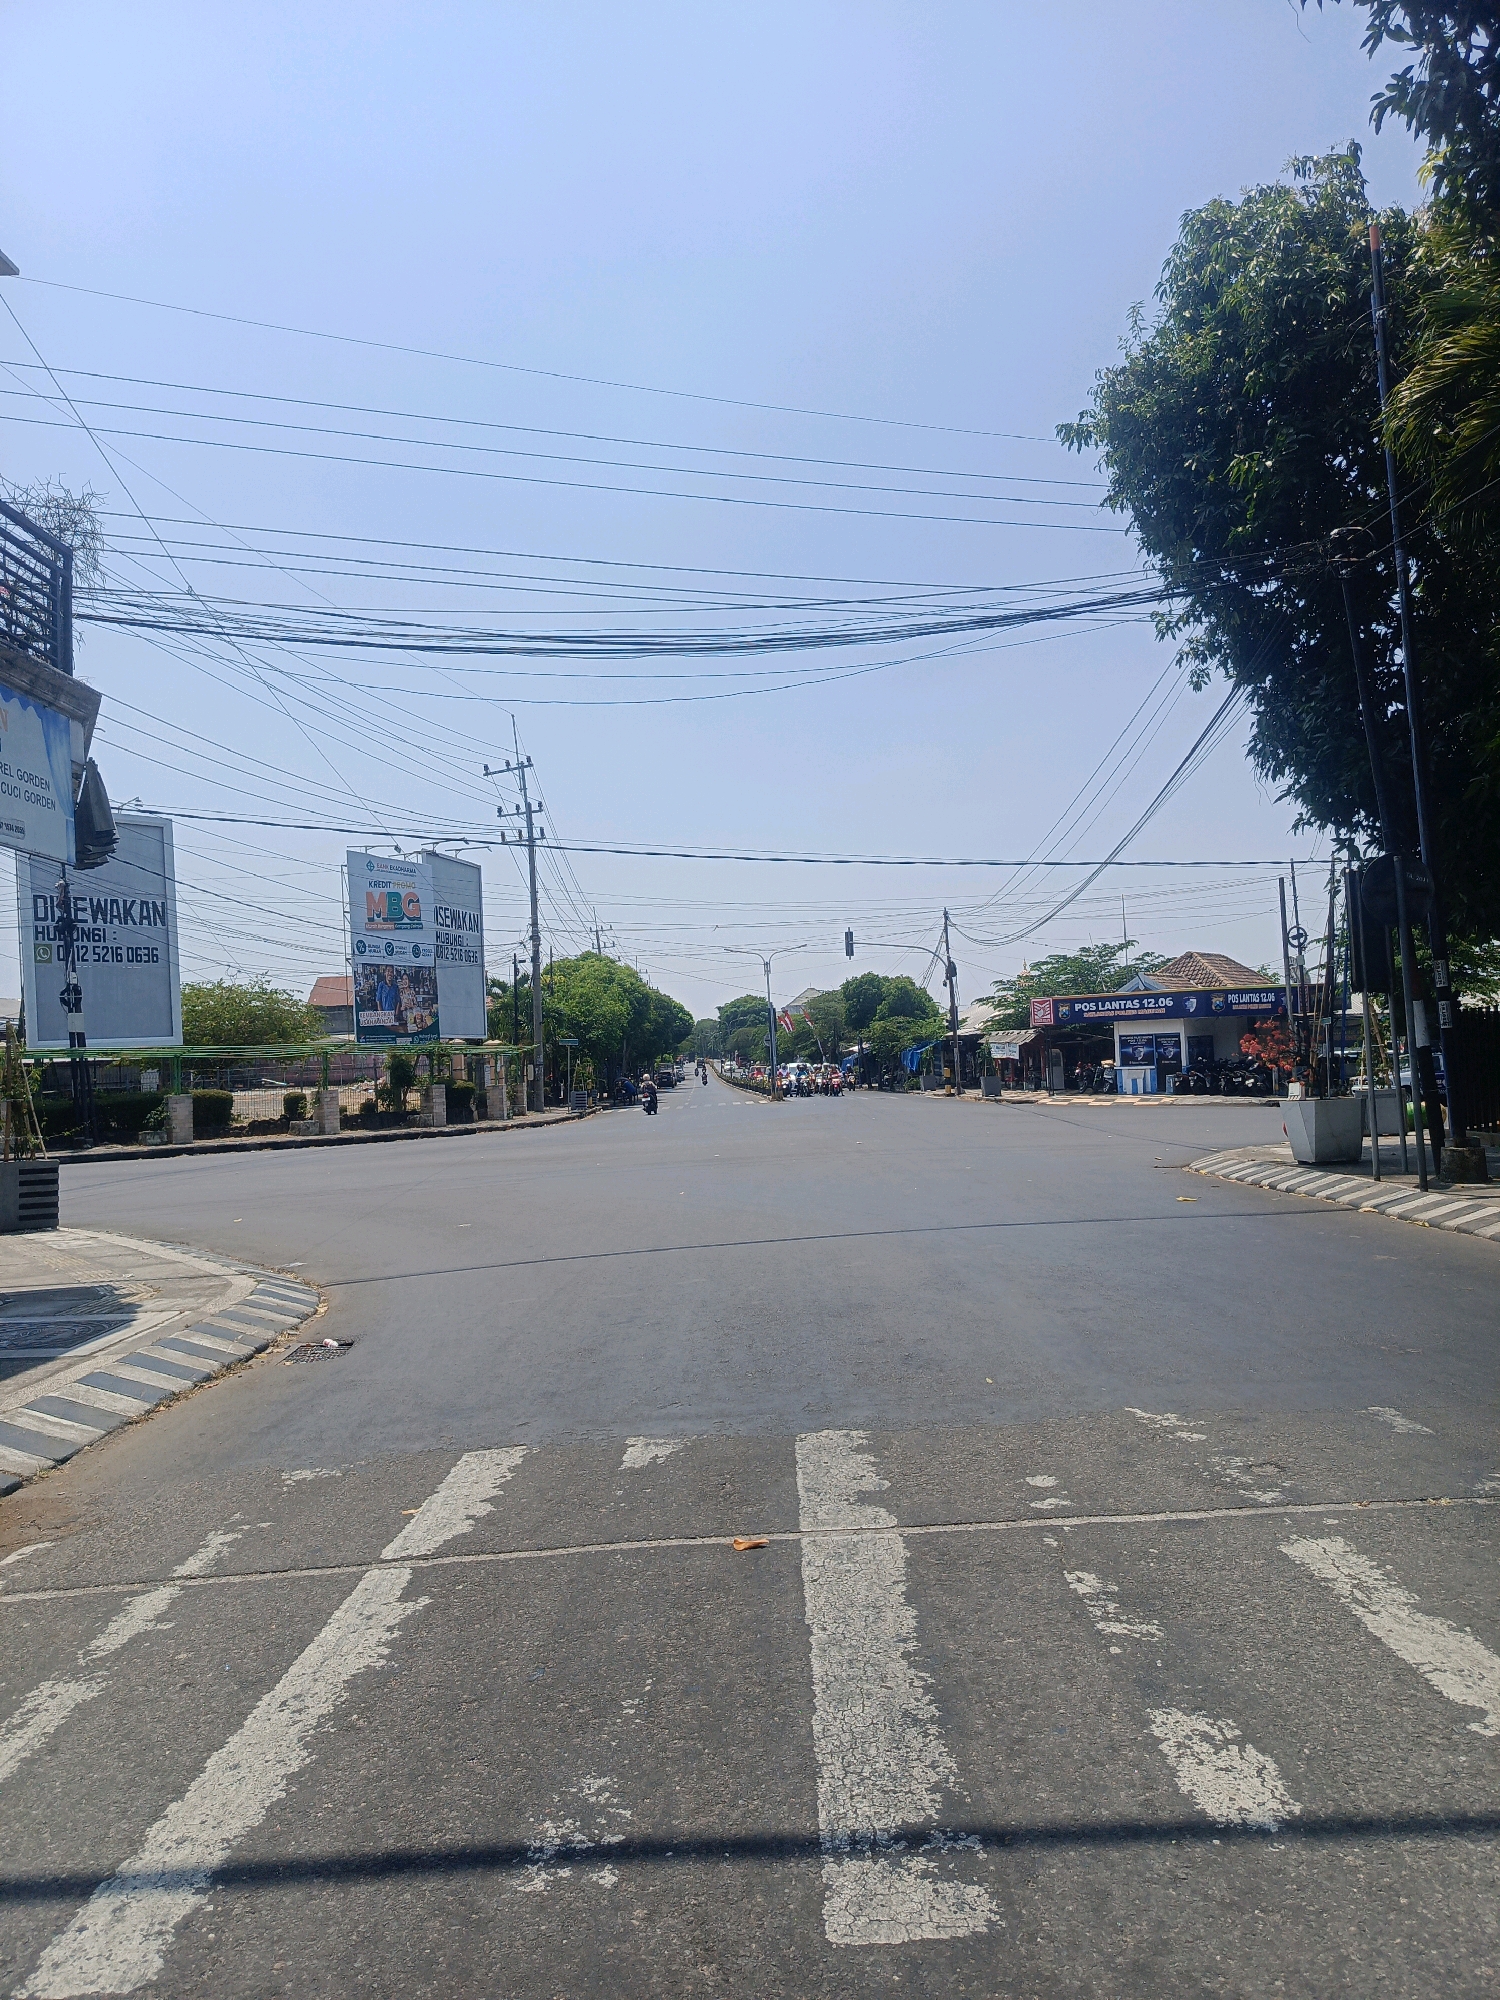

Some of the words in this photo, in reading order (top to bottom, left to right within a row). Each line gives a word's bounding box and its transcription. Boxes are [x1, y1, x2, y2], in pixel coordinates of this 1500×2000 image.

[16, 768, 50, 792] GORDEN
[1, 781, 21, 799] CUCI
[24, 790, 56, 811] GORDEN
[33, 894, 167, 927] DIEWAKAN
[366, 891, 421, 921] MBG
[56, 944, 90, 963] 012
[92, 945, 123, 963] 5216
[126, 946, 159, 964] 0636
[1074, 1002, 1097, 1012] POS
[1098, 999, 1140, 1010] LANTAS
[1142, 997, 1174, 1008] 12.06
[1227, 994, 1239, 1004] POS
[1239, 993, 1260, 1003] LANTAS
